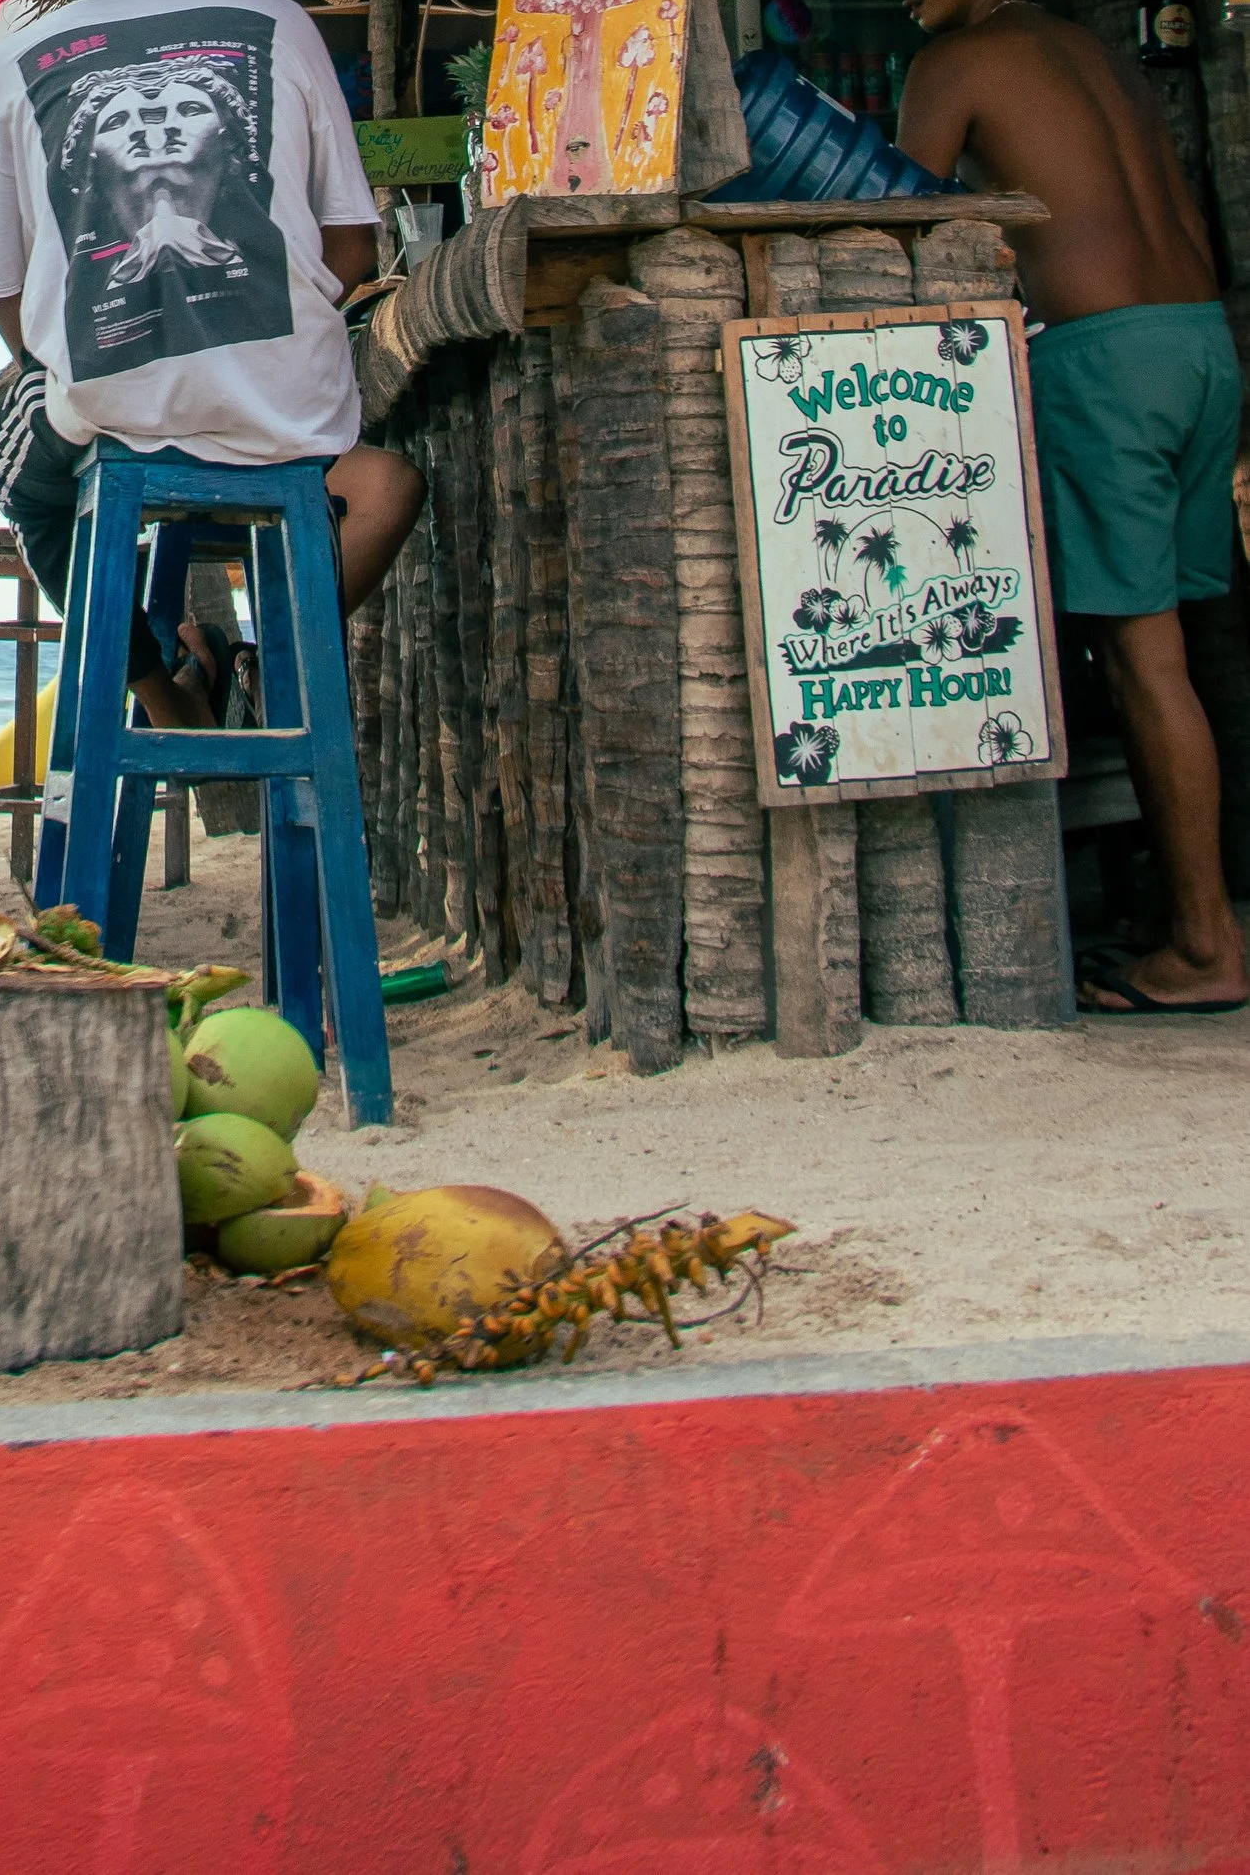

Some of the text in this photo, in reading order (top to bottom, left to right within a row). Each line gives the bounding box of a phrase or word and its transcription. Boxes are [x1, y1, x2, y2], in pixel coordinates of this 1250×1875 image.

[788, 362, 975, 424] Welcome
[872, 413, 908, 448] to
[779, 432, 994, 520] Paradise
[789, 574, 1012, 667] Where It's Always
